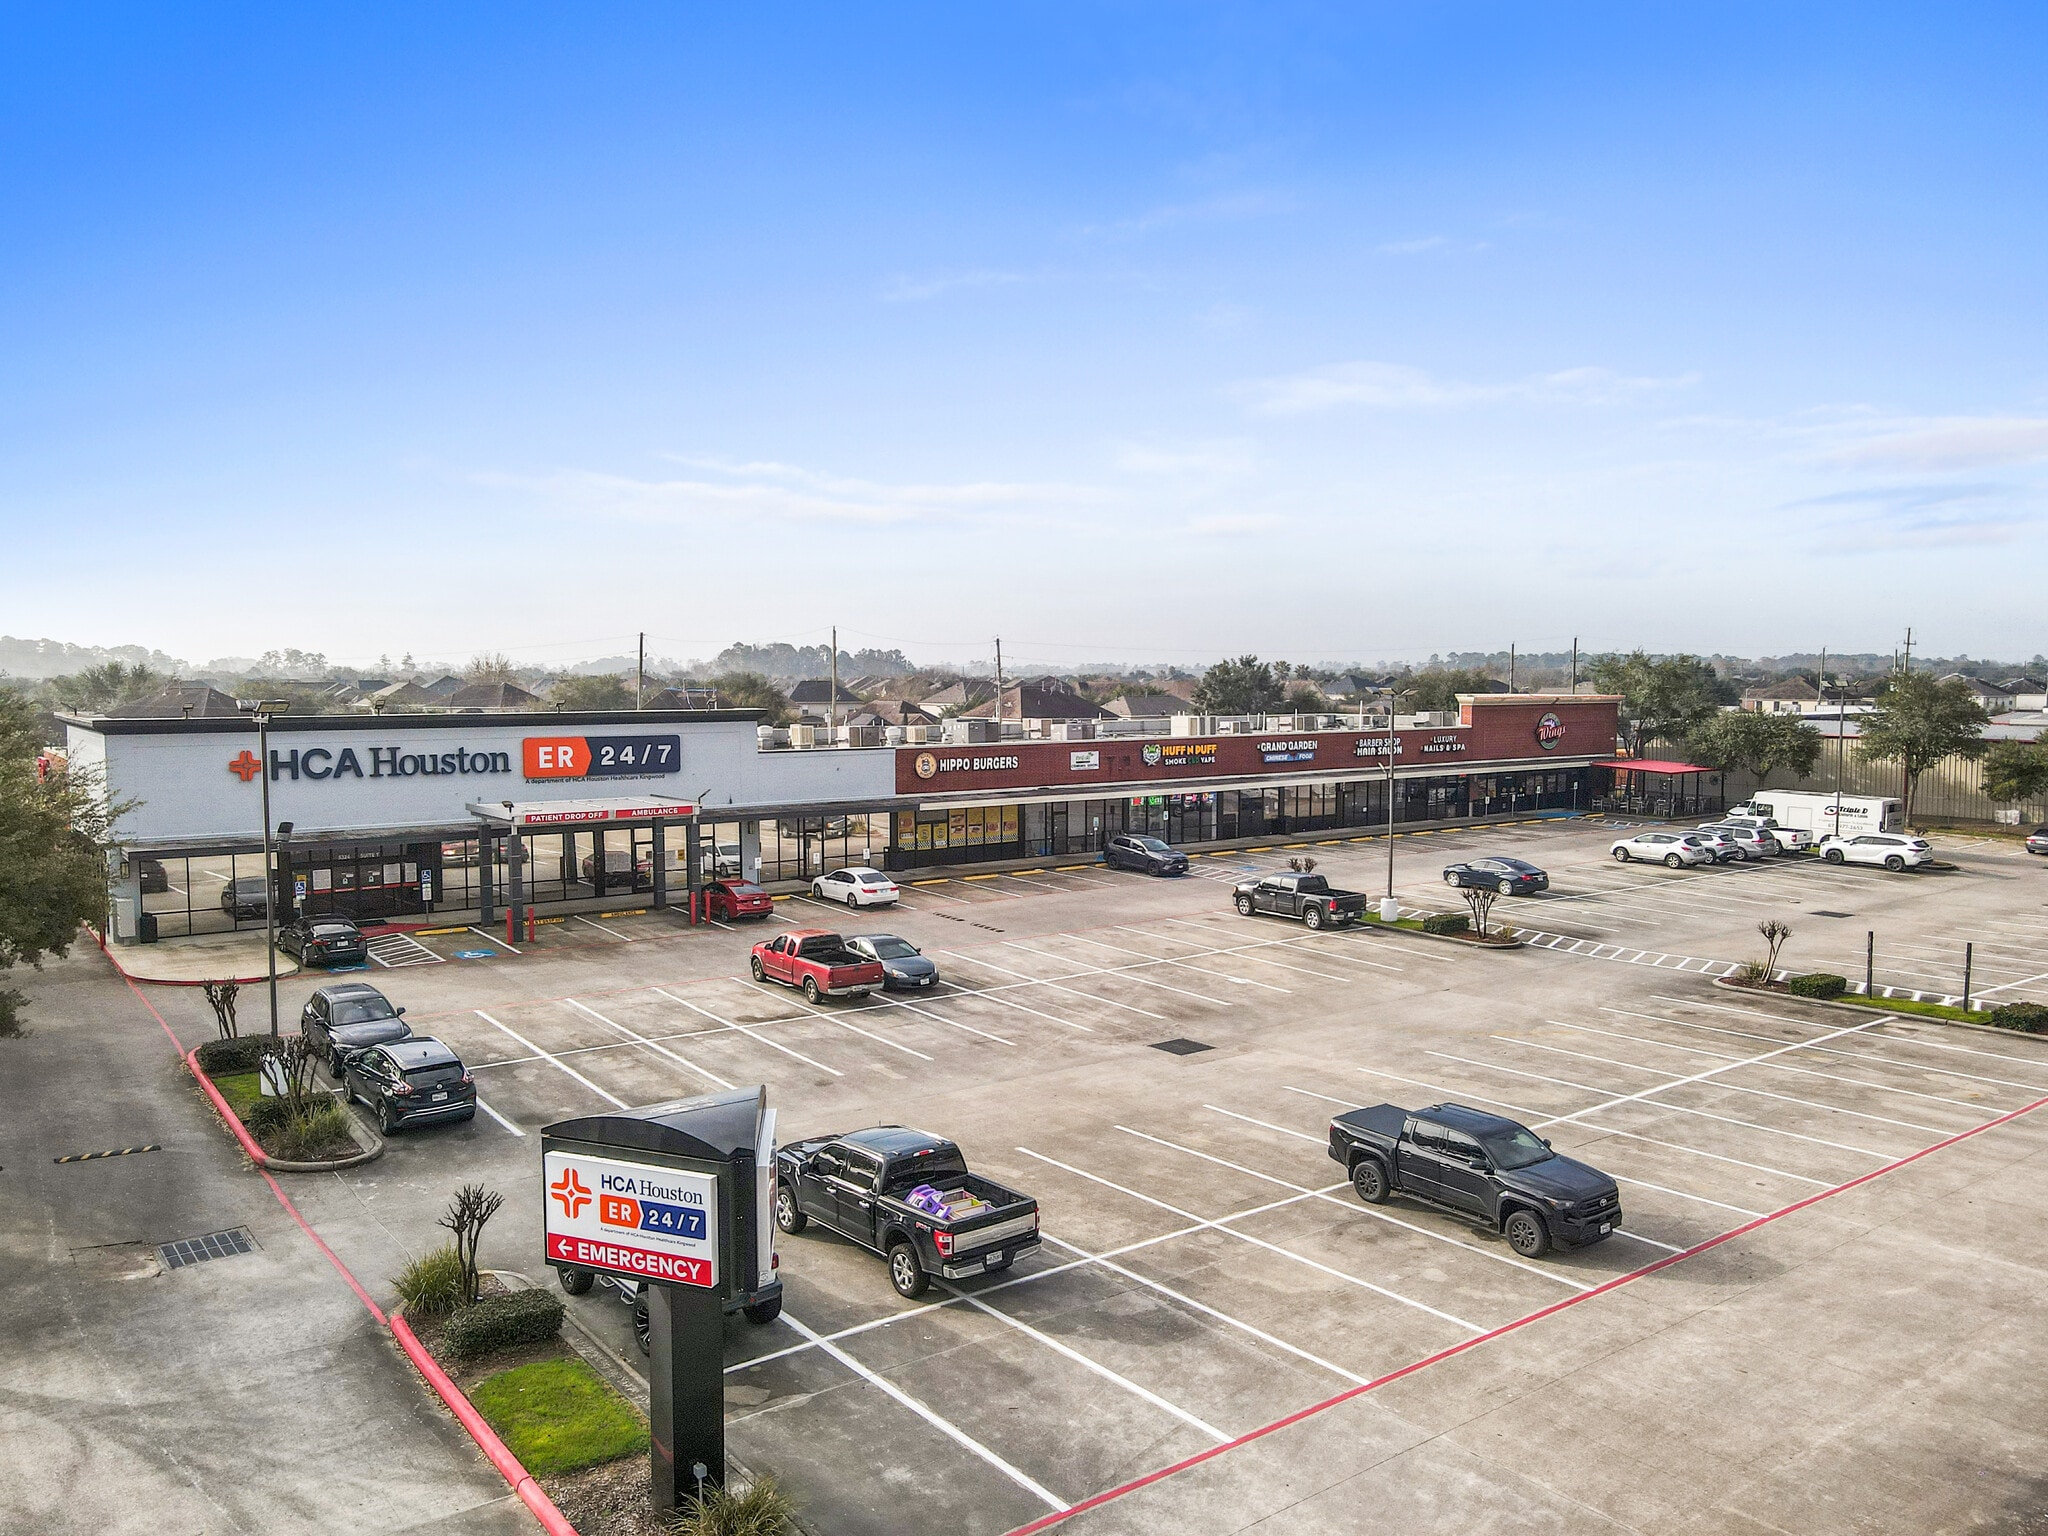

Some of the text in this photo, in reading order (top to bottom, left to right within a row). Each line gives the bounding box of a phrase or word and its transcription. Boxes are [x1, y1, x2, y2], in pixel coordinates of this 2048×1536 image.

[1433, 735, 1457, 743] LUXURY
[1538, 725, 1566, 741] Wings
[1261, 740, 1318, 752] GRAND GARDEN
[1359, 738, 1383, 747] BARBER
[1424, 744, 1444, 752] NAILS
[1452, 743, 1466, 751] SPA
[538, 744, 672, 769] ER 24/7
[1162, 745, 1186, 756] HUFF
[1187, 745, 1194, 755] N
[1357, 747, 1376, 756] HAIR
[270, 746, 512, 781] HCA Houston
[939, 757, 970, 772] HIPPO
[973, 756, 1019, 770] BURGERS
[1164, 757, 1187, 766] SMOKE
[531, 777, 564, 785] department
[639, 773, 665, 781] Kingwood
[565, 813, 587, 821] DROP
[631, 807, 679, 816] AMBULANCE
[601, 1174, 704, 1205] HCA Houston
[608, 1201, 700, 1231] ER 24/7
[578, 1242, 701, 1280] EMERGENCY
